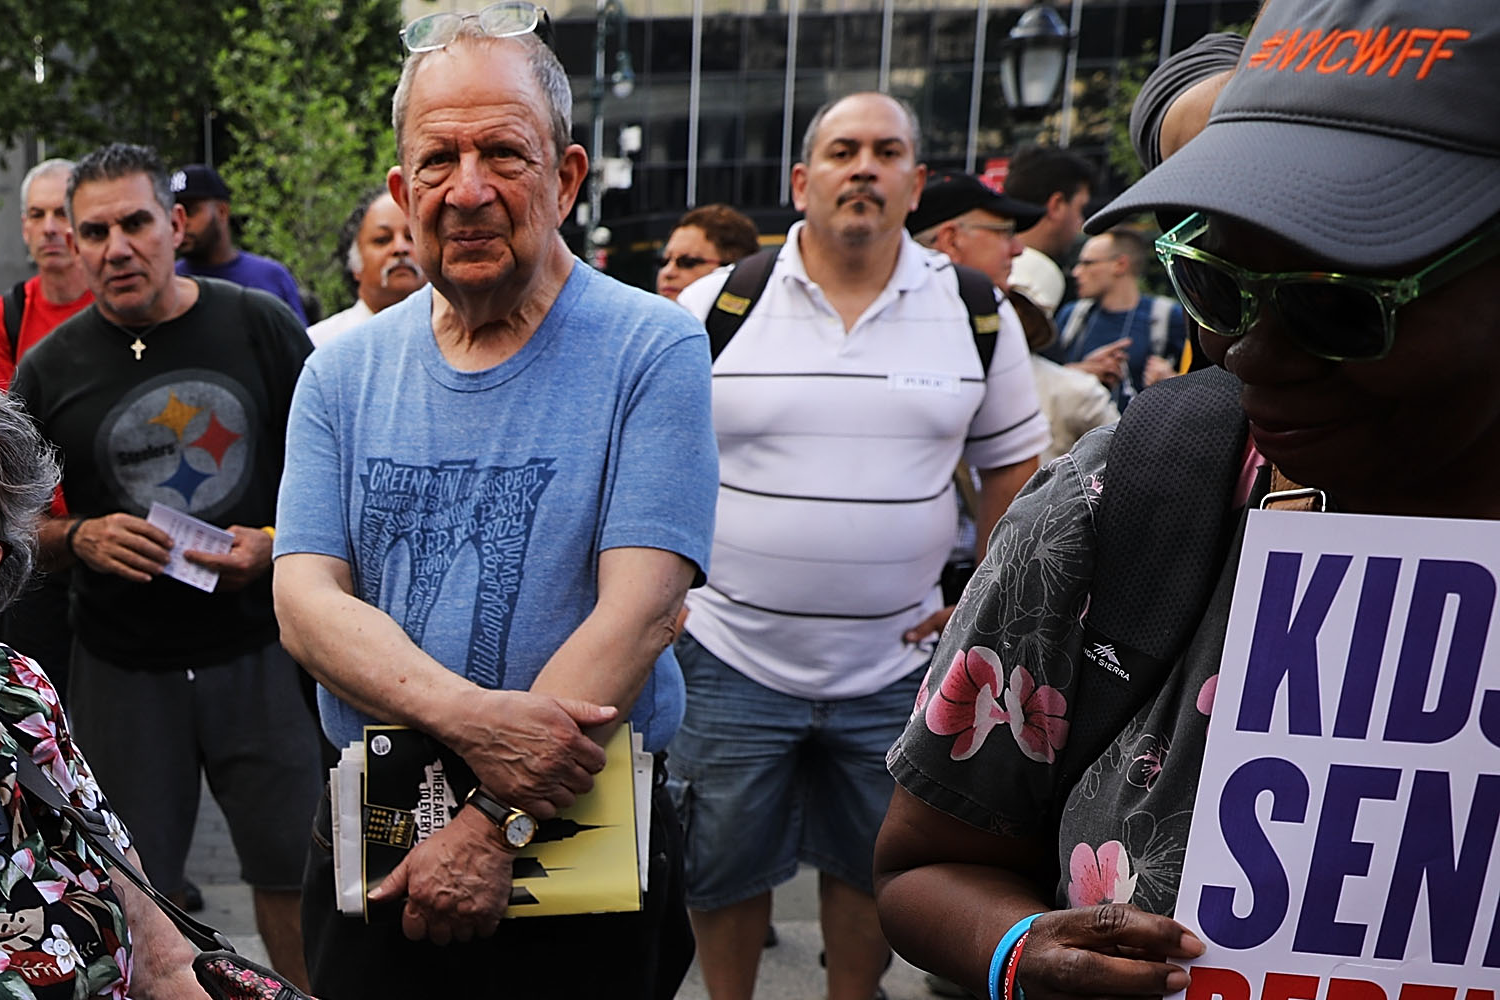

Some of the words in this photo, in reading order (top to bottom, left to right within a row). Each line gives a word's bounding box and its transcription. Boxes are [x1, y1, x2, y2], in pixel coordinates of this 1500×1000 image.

[1247, 26, 1471, 80] #NYCWFF
[370, 461, 470, 503] GREENPOINT
[480, 480, 543, 523] PARK
[411, 529, 450, 559] RED
[496, 535, 526, 593] DUMBO
[1083, 647, 1097, 661] IGH
[1098, 658, 1131, 681] SIERRA
[420, 788, 431, 800] TO
[432, 768, 444, 802] THERE
[420, 802, 431, 834] EVERY
[432, 803, 444, 824] ARE
[1196, 757, 1500, 968] SEN
